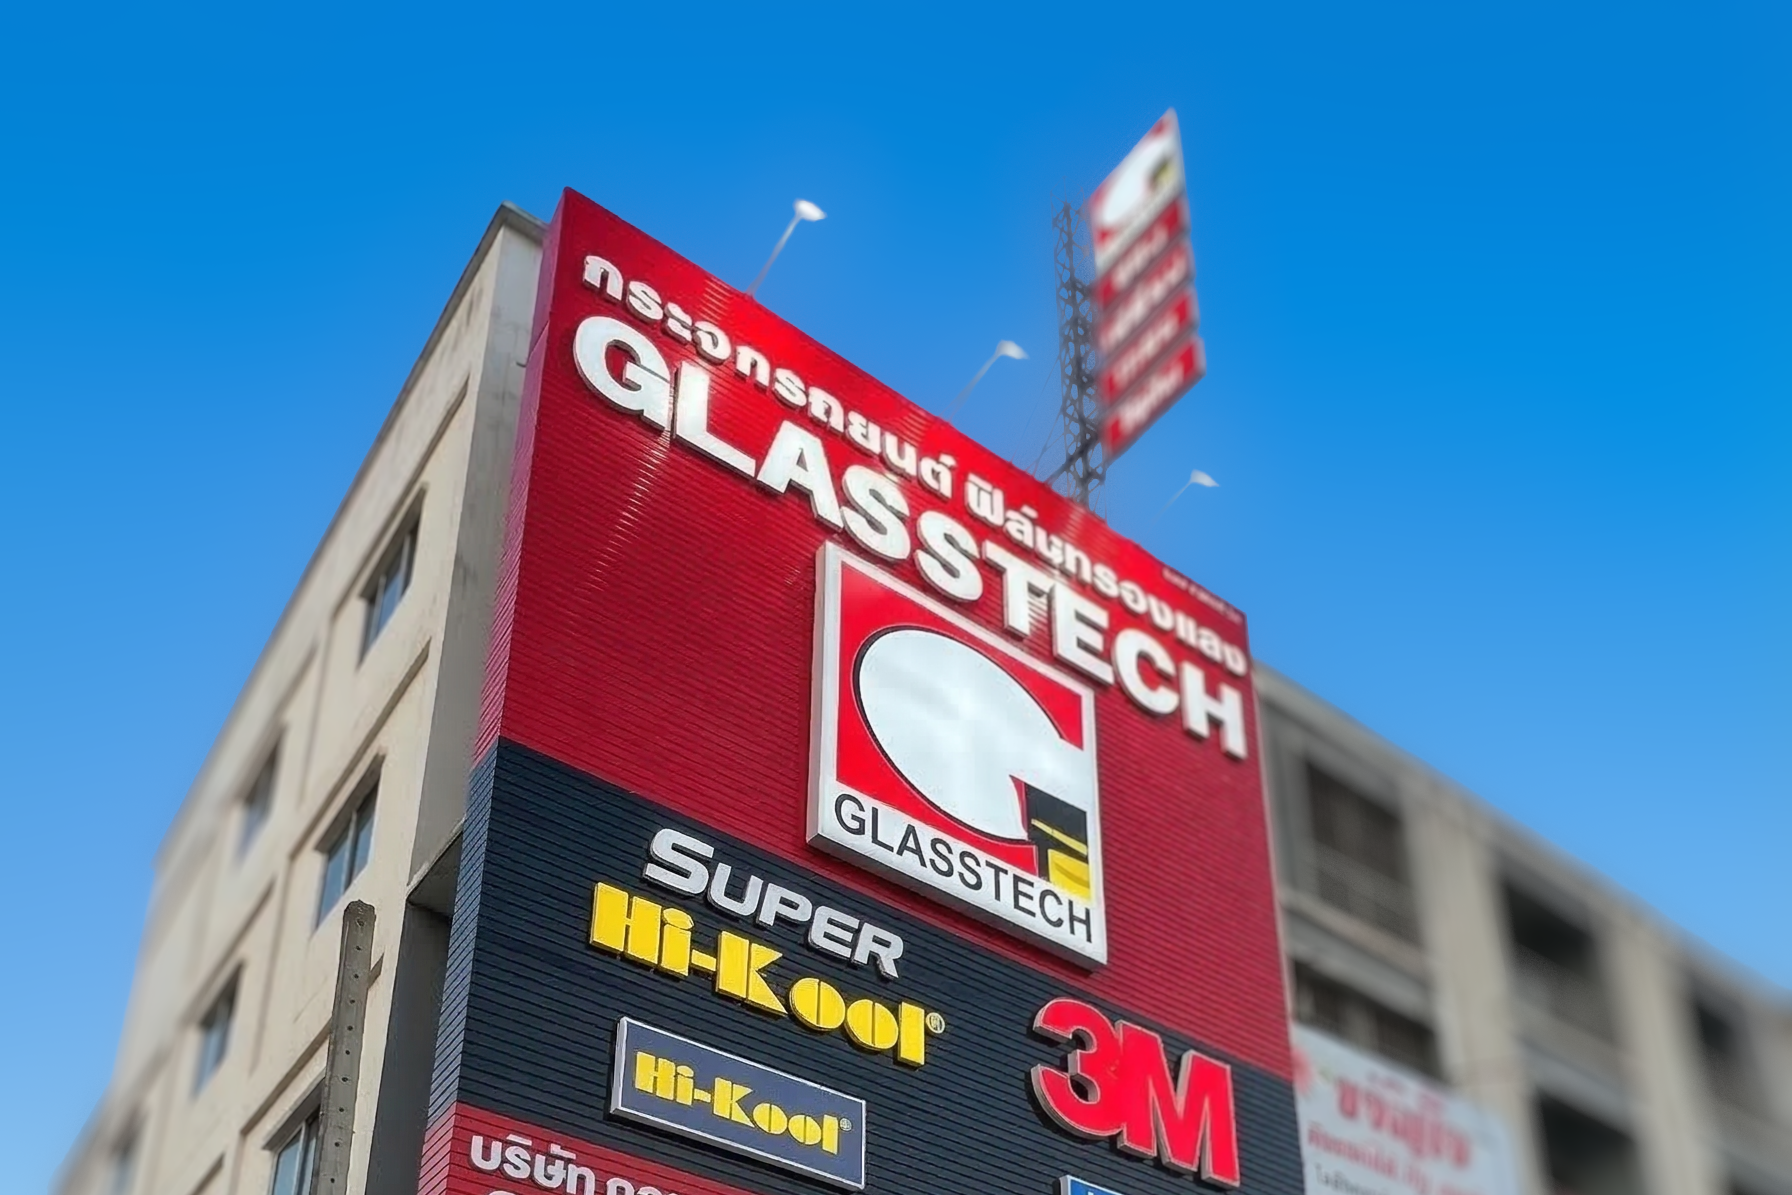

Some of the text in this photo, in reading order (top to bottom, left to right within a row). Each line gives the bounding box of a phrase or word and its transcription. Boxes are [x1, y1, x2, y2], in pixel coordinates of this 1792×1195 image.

[582, 254, 957, 499] กระจกรถยนต์
[572, 315, 1247, 761] GLASSTECH
[643, 828, 904, 980] SUPER
[834, 793, 1092, 943] GLASSTECH
[1031, 997, 1240, 1188] 3M
